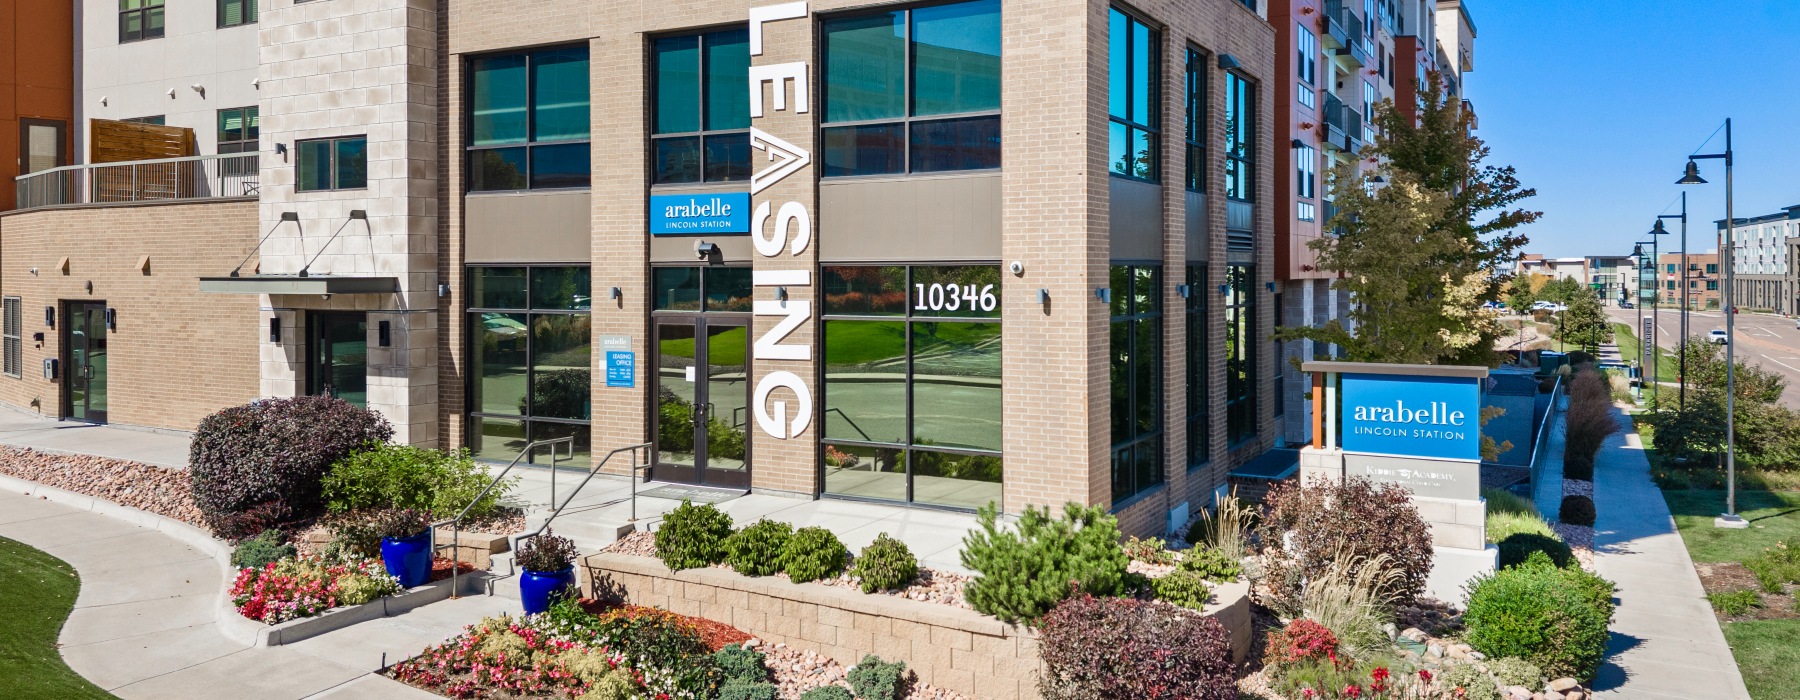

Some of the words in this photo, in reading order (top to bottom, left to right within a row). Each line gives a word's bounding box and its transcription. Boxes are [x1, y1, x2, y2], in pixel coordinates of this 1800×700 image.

[665, 197, 731, 218] arabelle
[665, 221, 698, 229] LINCOLN
[700, 220, 731, 228] STATION
[749, 2, 813, 440] LEASING
[914, 282, 997, 312] 10346
[604, 337, 627, 345] arabelle
[1354, 399, 1465, 426] arabelle
[1354, 426, 1407, 437] LINCOLN
[1413, 429, 1465, 441] STATION
